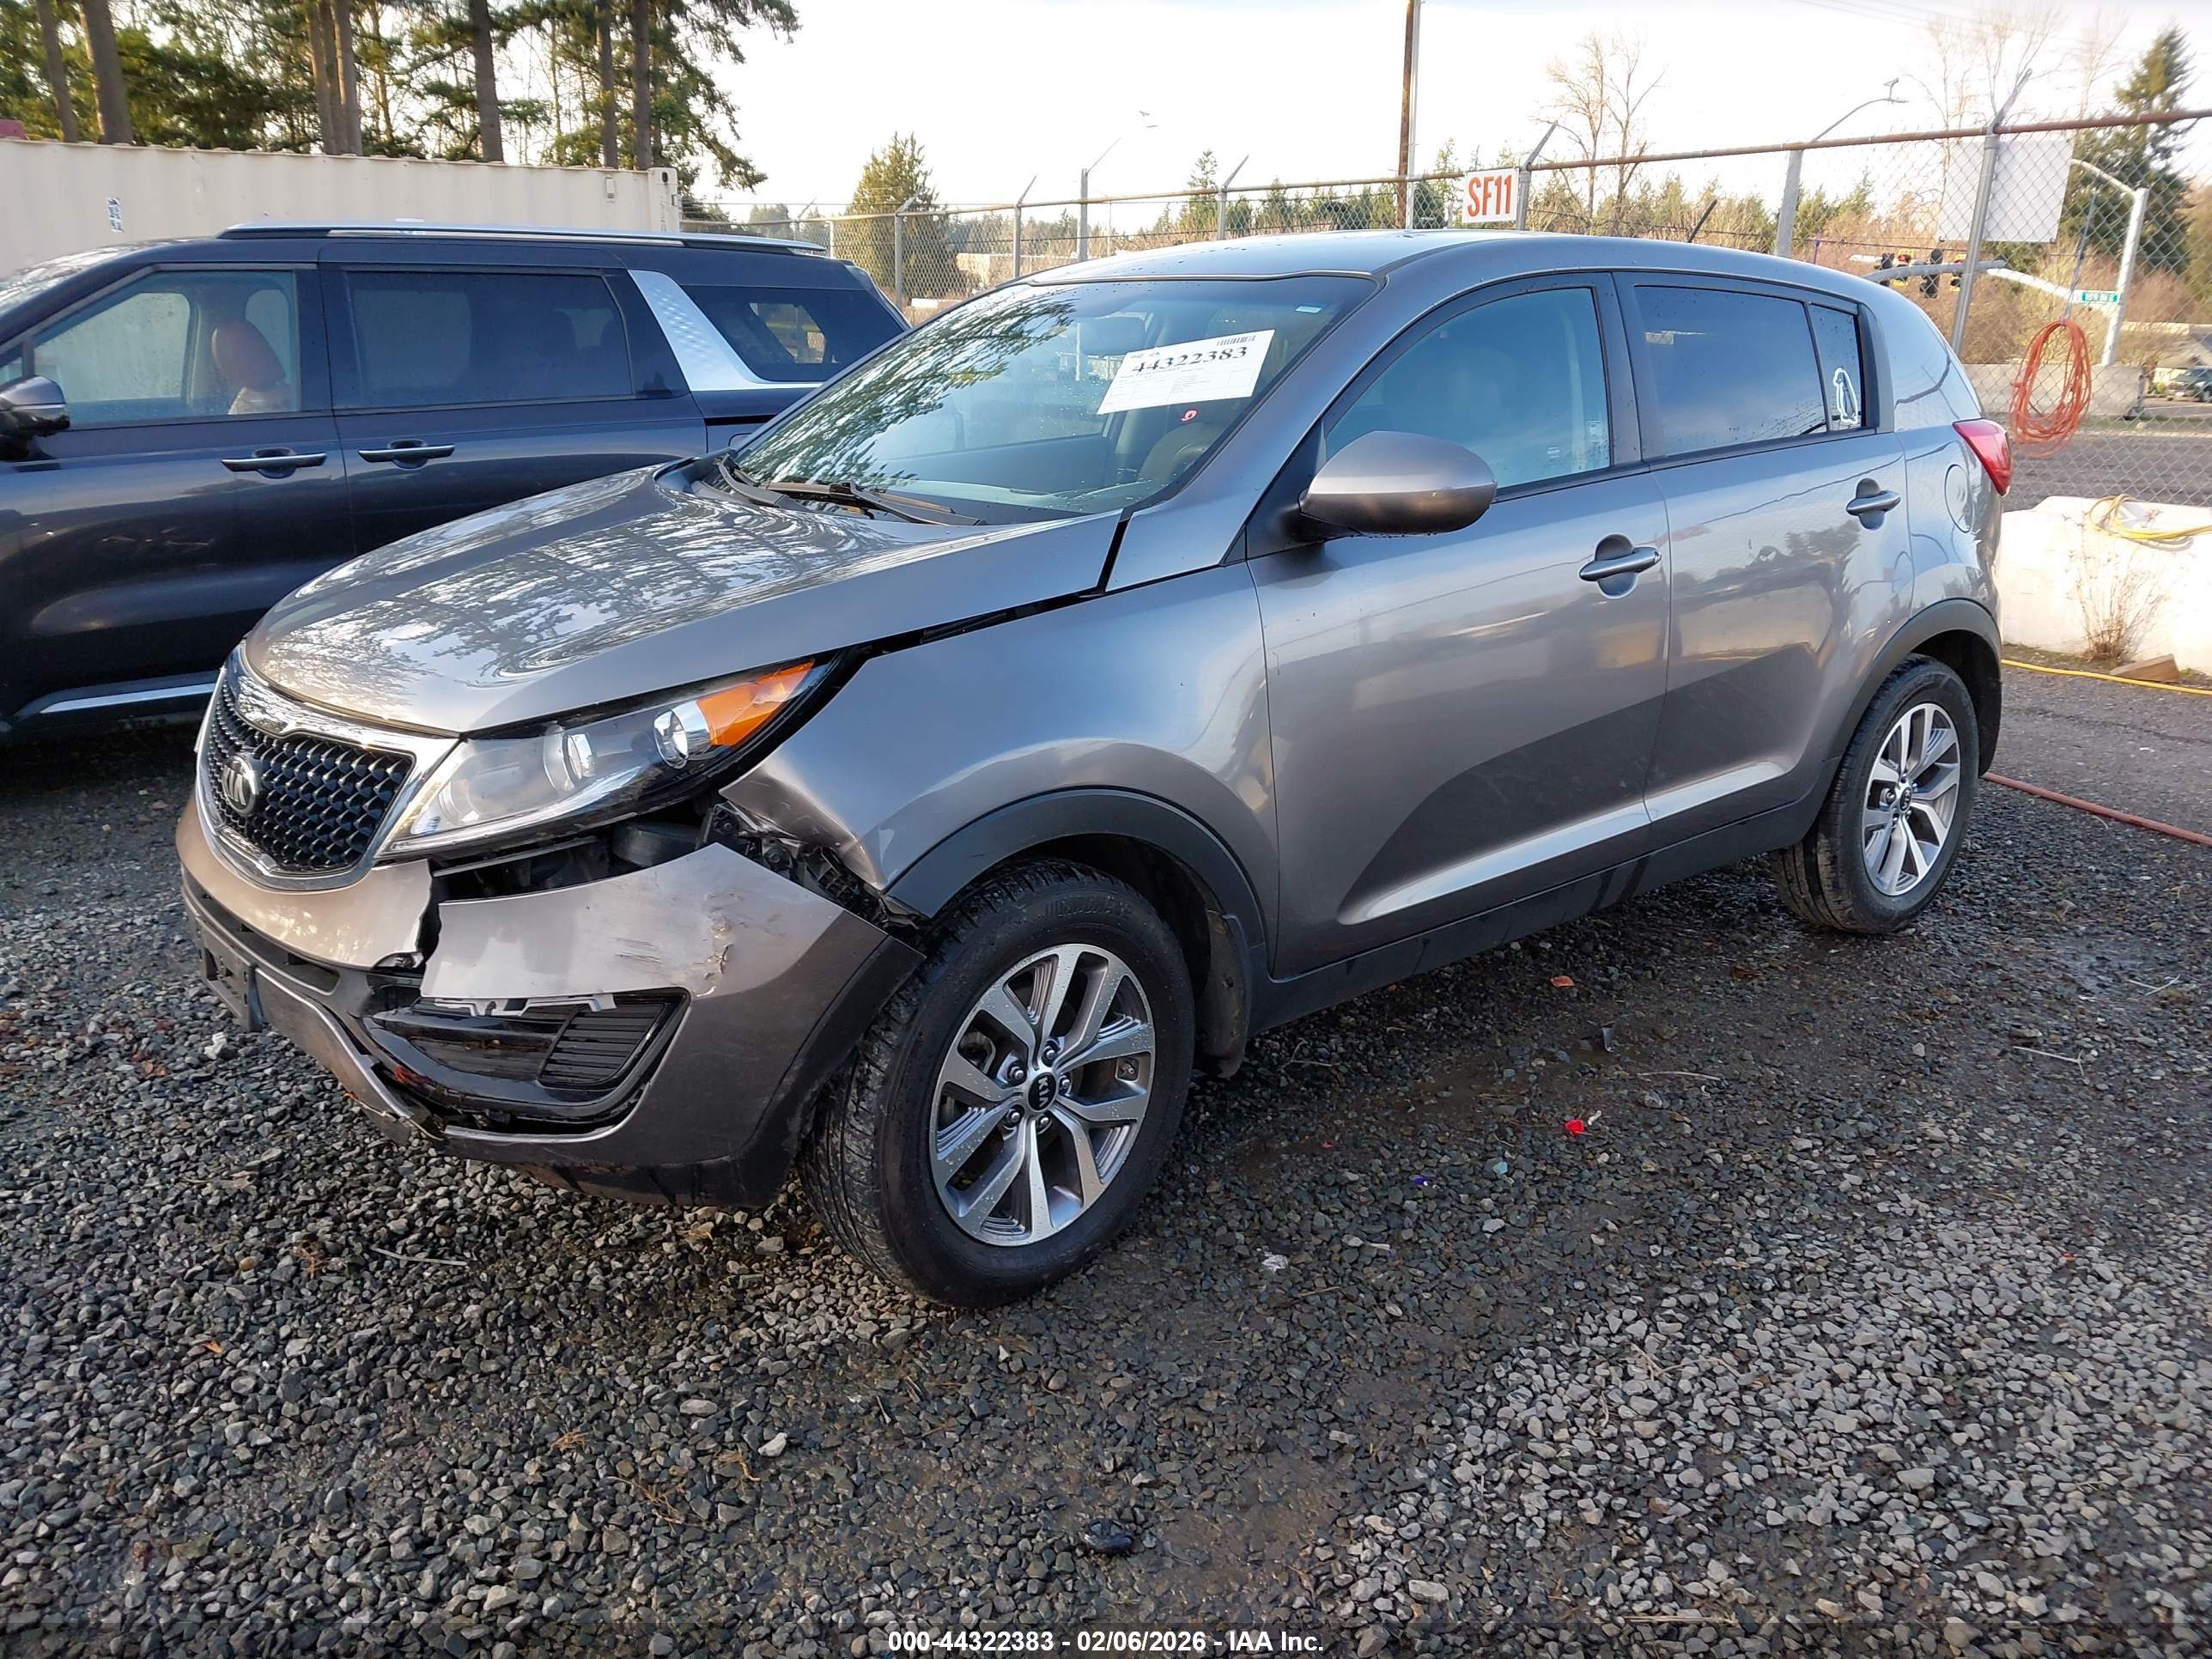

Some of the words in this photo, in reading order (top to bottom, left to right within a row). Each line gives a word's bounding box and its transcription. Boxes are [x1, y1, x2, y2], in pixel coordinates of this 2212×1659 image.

[1468, 174, 1512, 217] SF11
[1131, 346, 1249, 373] 44322383
[1037, 1076, 1050, 1108] KIA
